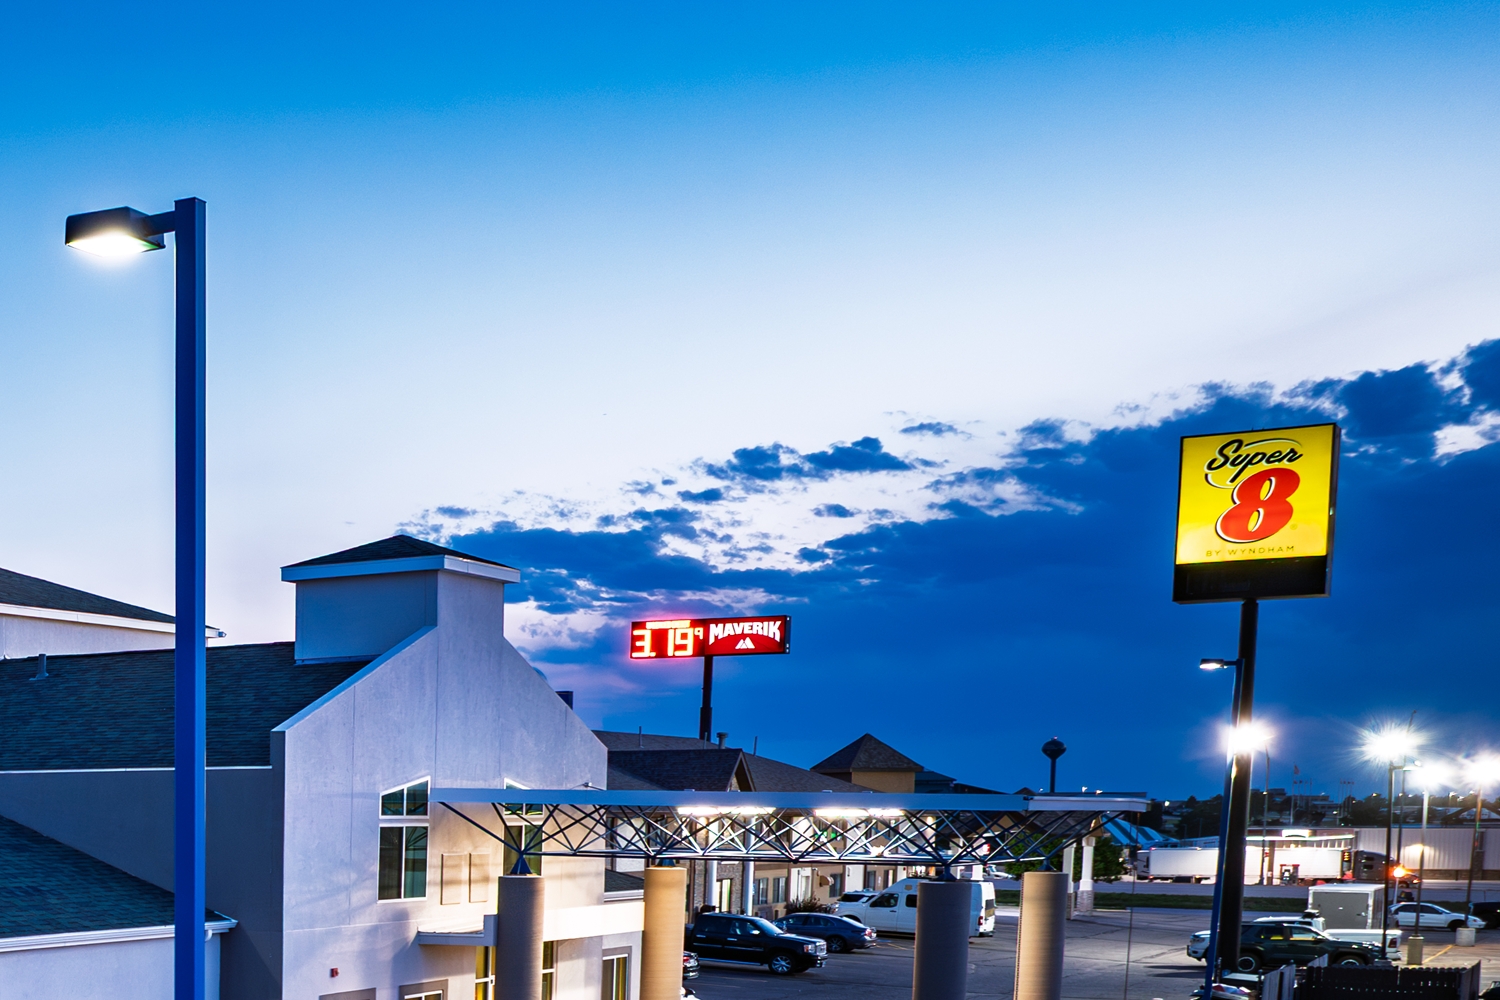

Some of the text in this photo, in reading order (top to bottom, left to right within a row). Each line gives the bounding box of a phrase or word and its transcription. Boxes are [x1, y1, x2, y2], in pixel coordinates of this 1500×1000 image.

[1205, 438, 1304, 484] Super
[1214, 466, 1301, 544] 8
[1228, 545, 1296, 556] WYNDHAM
[708, 620, 782, 646] MAVERIK
